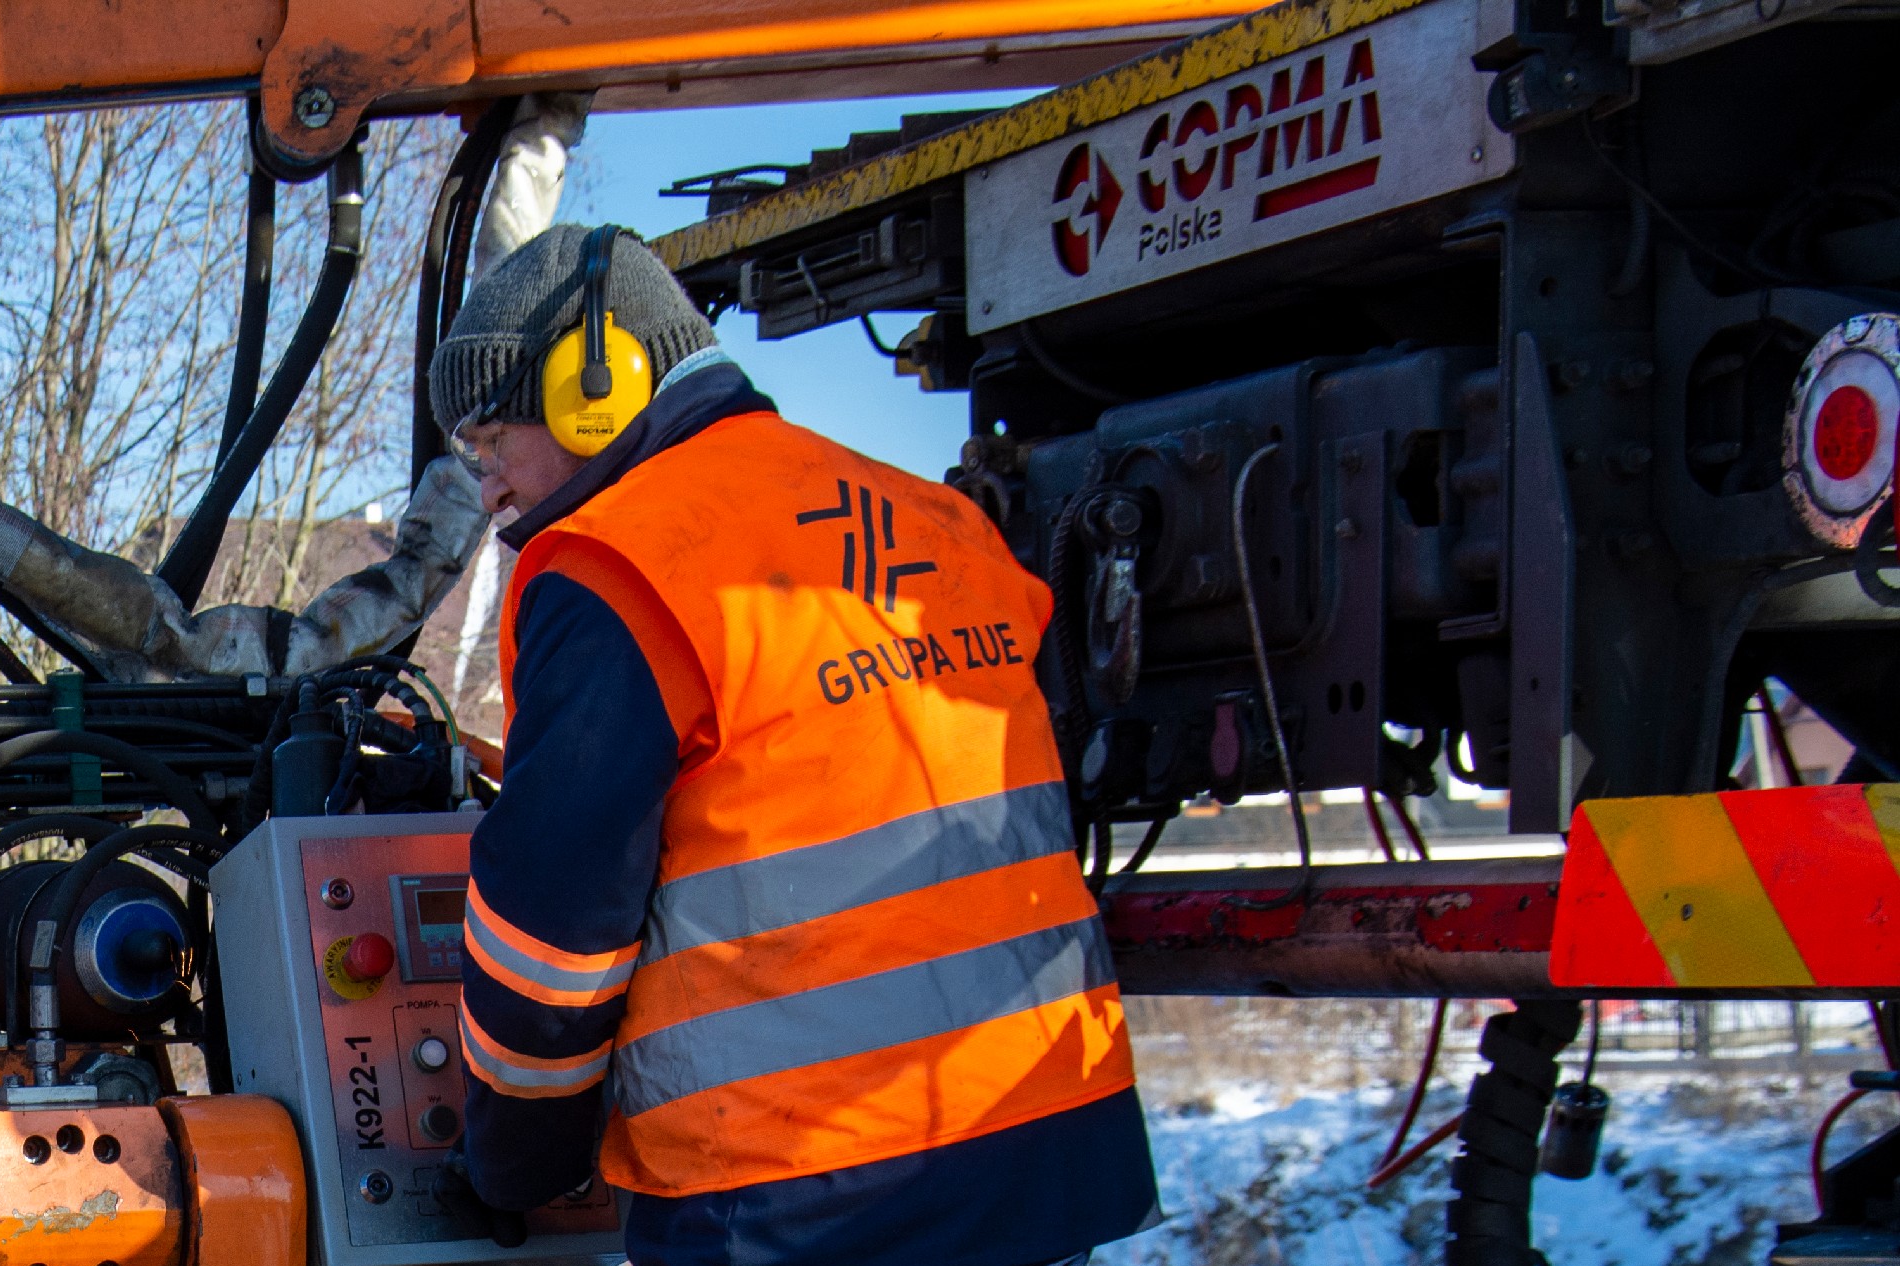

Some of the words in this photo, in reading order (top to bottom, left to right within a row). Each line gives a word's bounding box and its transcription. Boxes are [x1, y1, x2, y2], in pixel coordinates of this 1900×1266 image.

[1138, 205, 1222, 261] Polska
[818, 633, 957, 705] GRUPA
[952, 622, 1023, 670] ZUE
[407, 1000, 440, 1009] POMPA
[344, 1035, 387, 1151] K922-1
